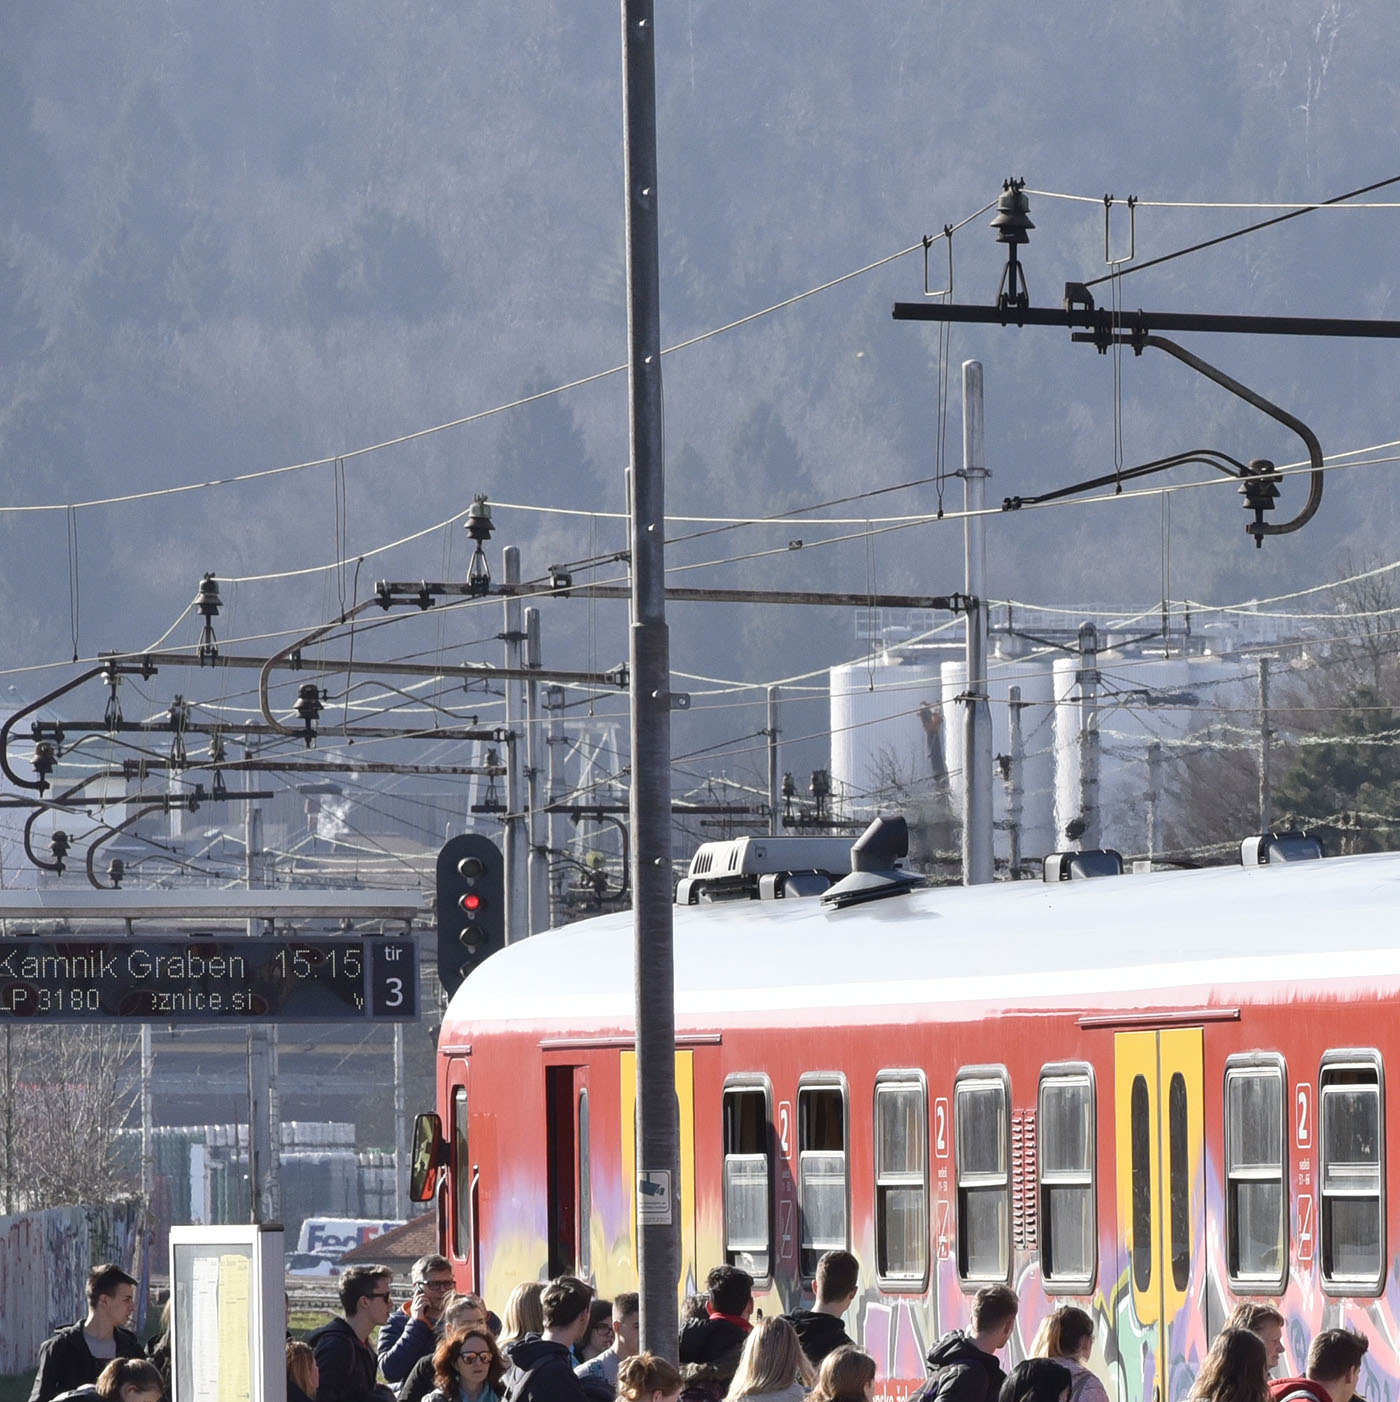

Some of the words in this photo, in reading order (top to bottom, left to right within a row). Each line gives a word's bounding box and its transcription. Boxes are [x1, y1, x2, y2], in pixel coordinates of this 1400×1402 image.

[127, 949, 245, 978] Graben
[275, 949, 361, 978] 15:15
[384, 945, 403, 961] tir
[38, 988, 100, 1010] 3180
[385, 977, 404, 1007] 3
[936, 1105, 946, 1150] 2
[1298, 1091, 1308, 1139] 2
[780, 1108, 789, 1152] 2
[308, 1223, 401, 1250] FedE
